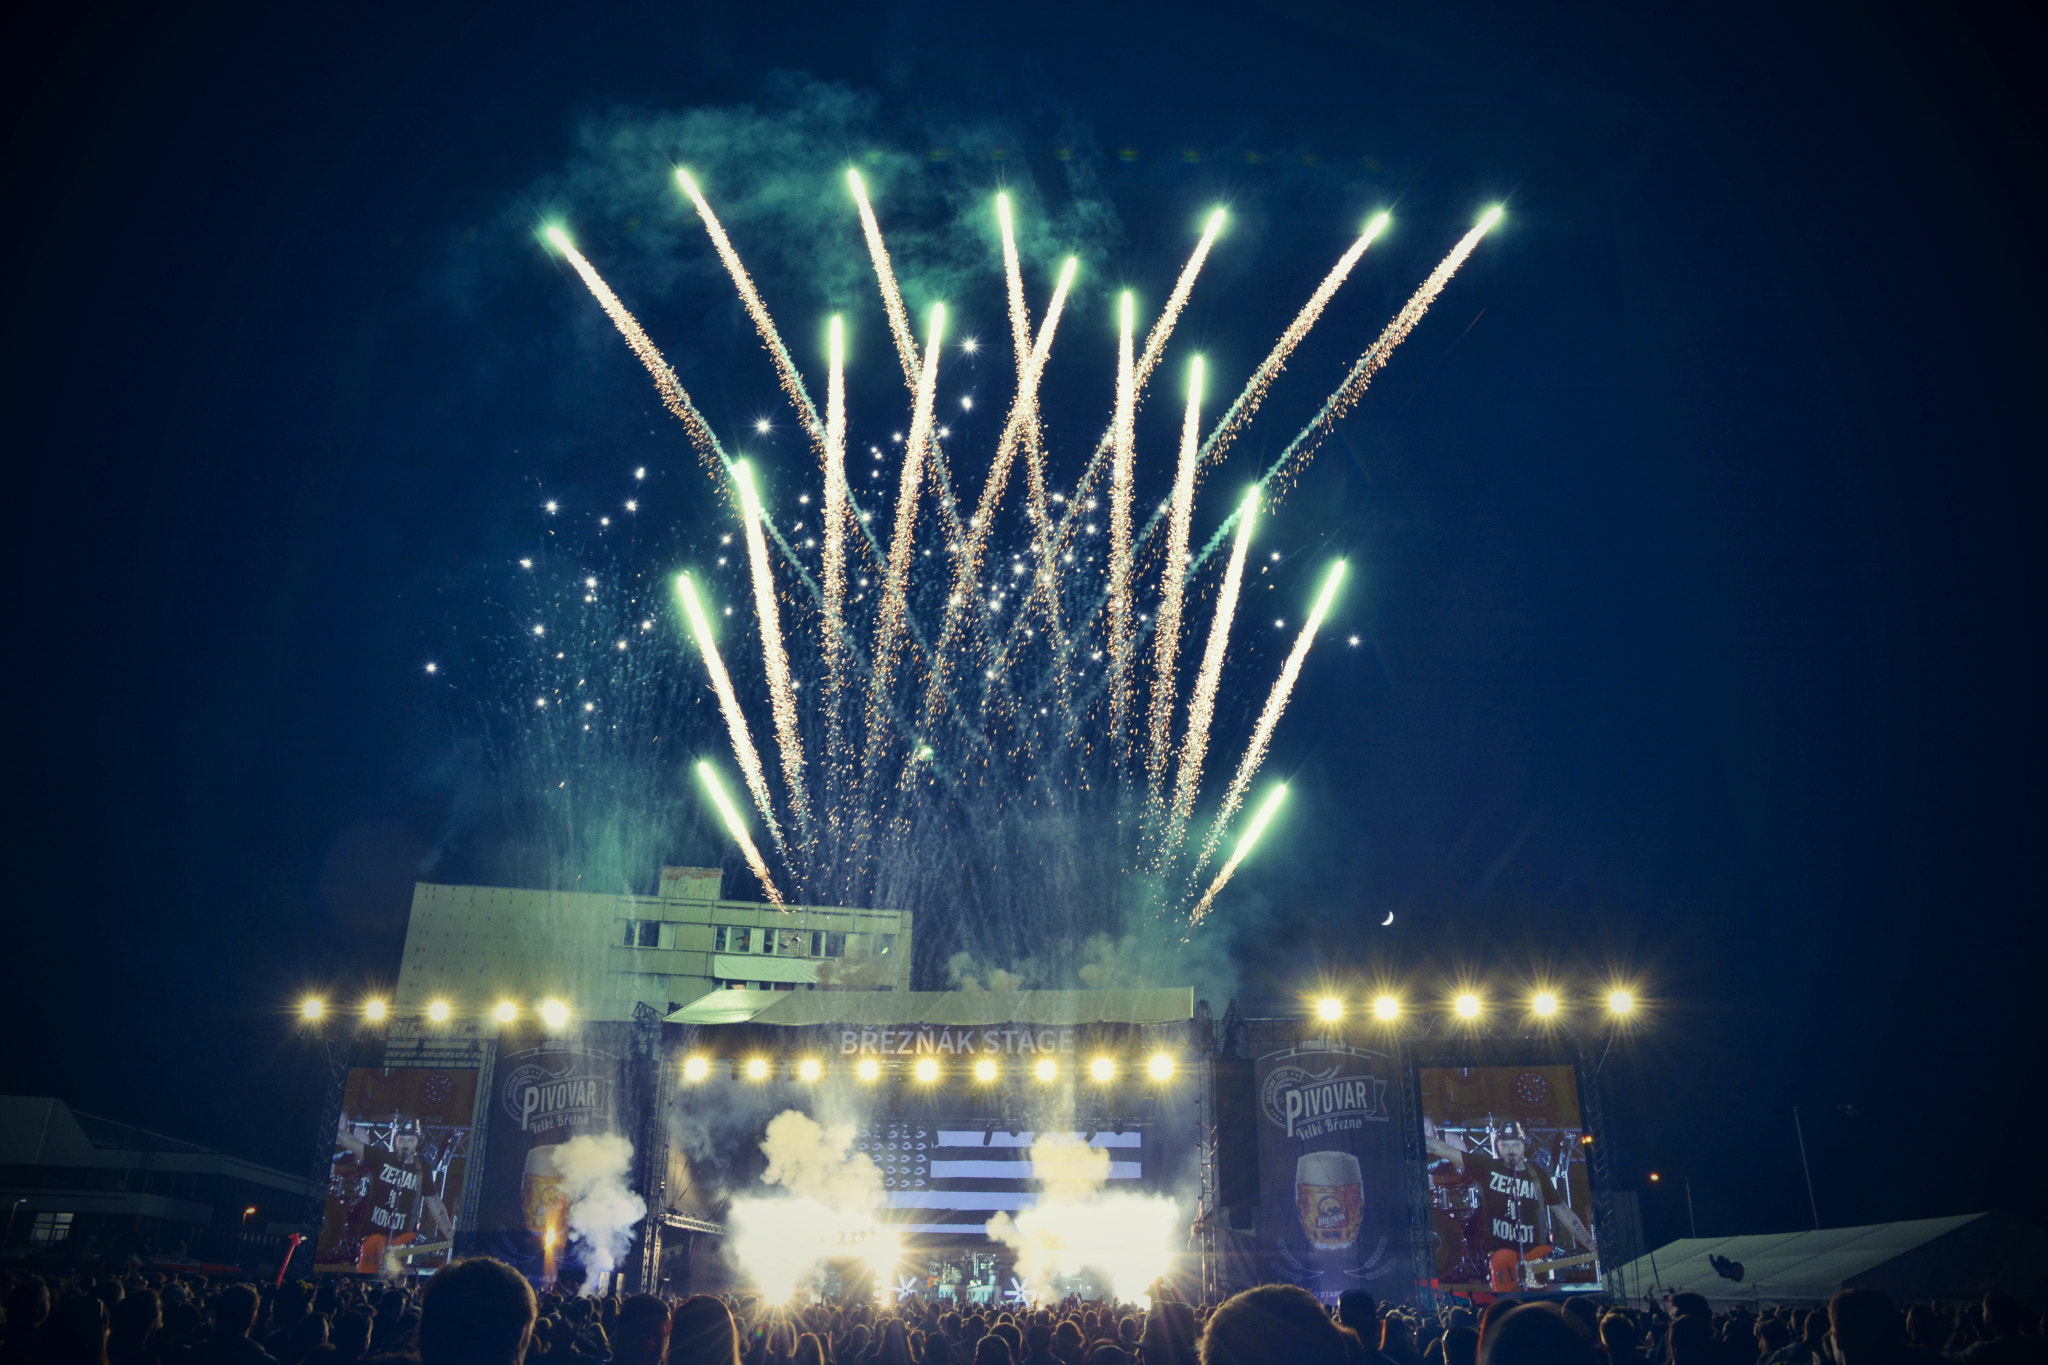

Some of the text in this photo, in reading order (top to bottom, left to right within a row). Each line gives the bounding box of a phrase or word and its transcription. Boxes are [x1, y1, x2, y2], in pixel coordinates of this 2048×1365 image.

[840, 1025, 1074, 1055] BŘEZŇÁK STAGE
[521, 1081, 597, 1131] PIVOVAR
[1286, 1081, 1367, 1138] PIVOVAR
[530, 1114, 589, 1134] Velké Březno
[1295, 1118, 1363, 1141] Velké Březno
